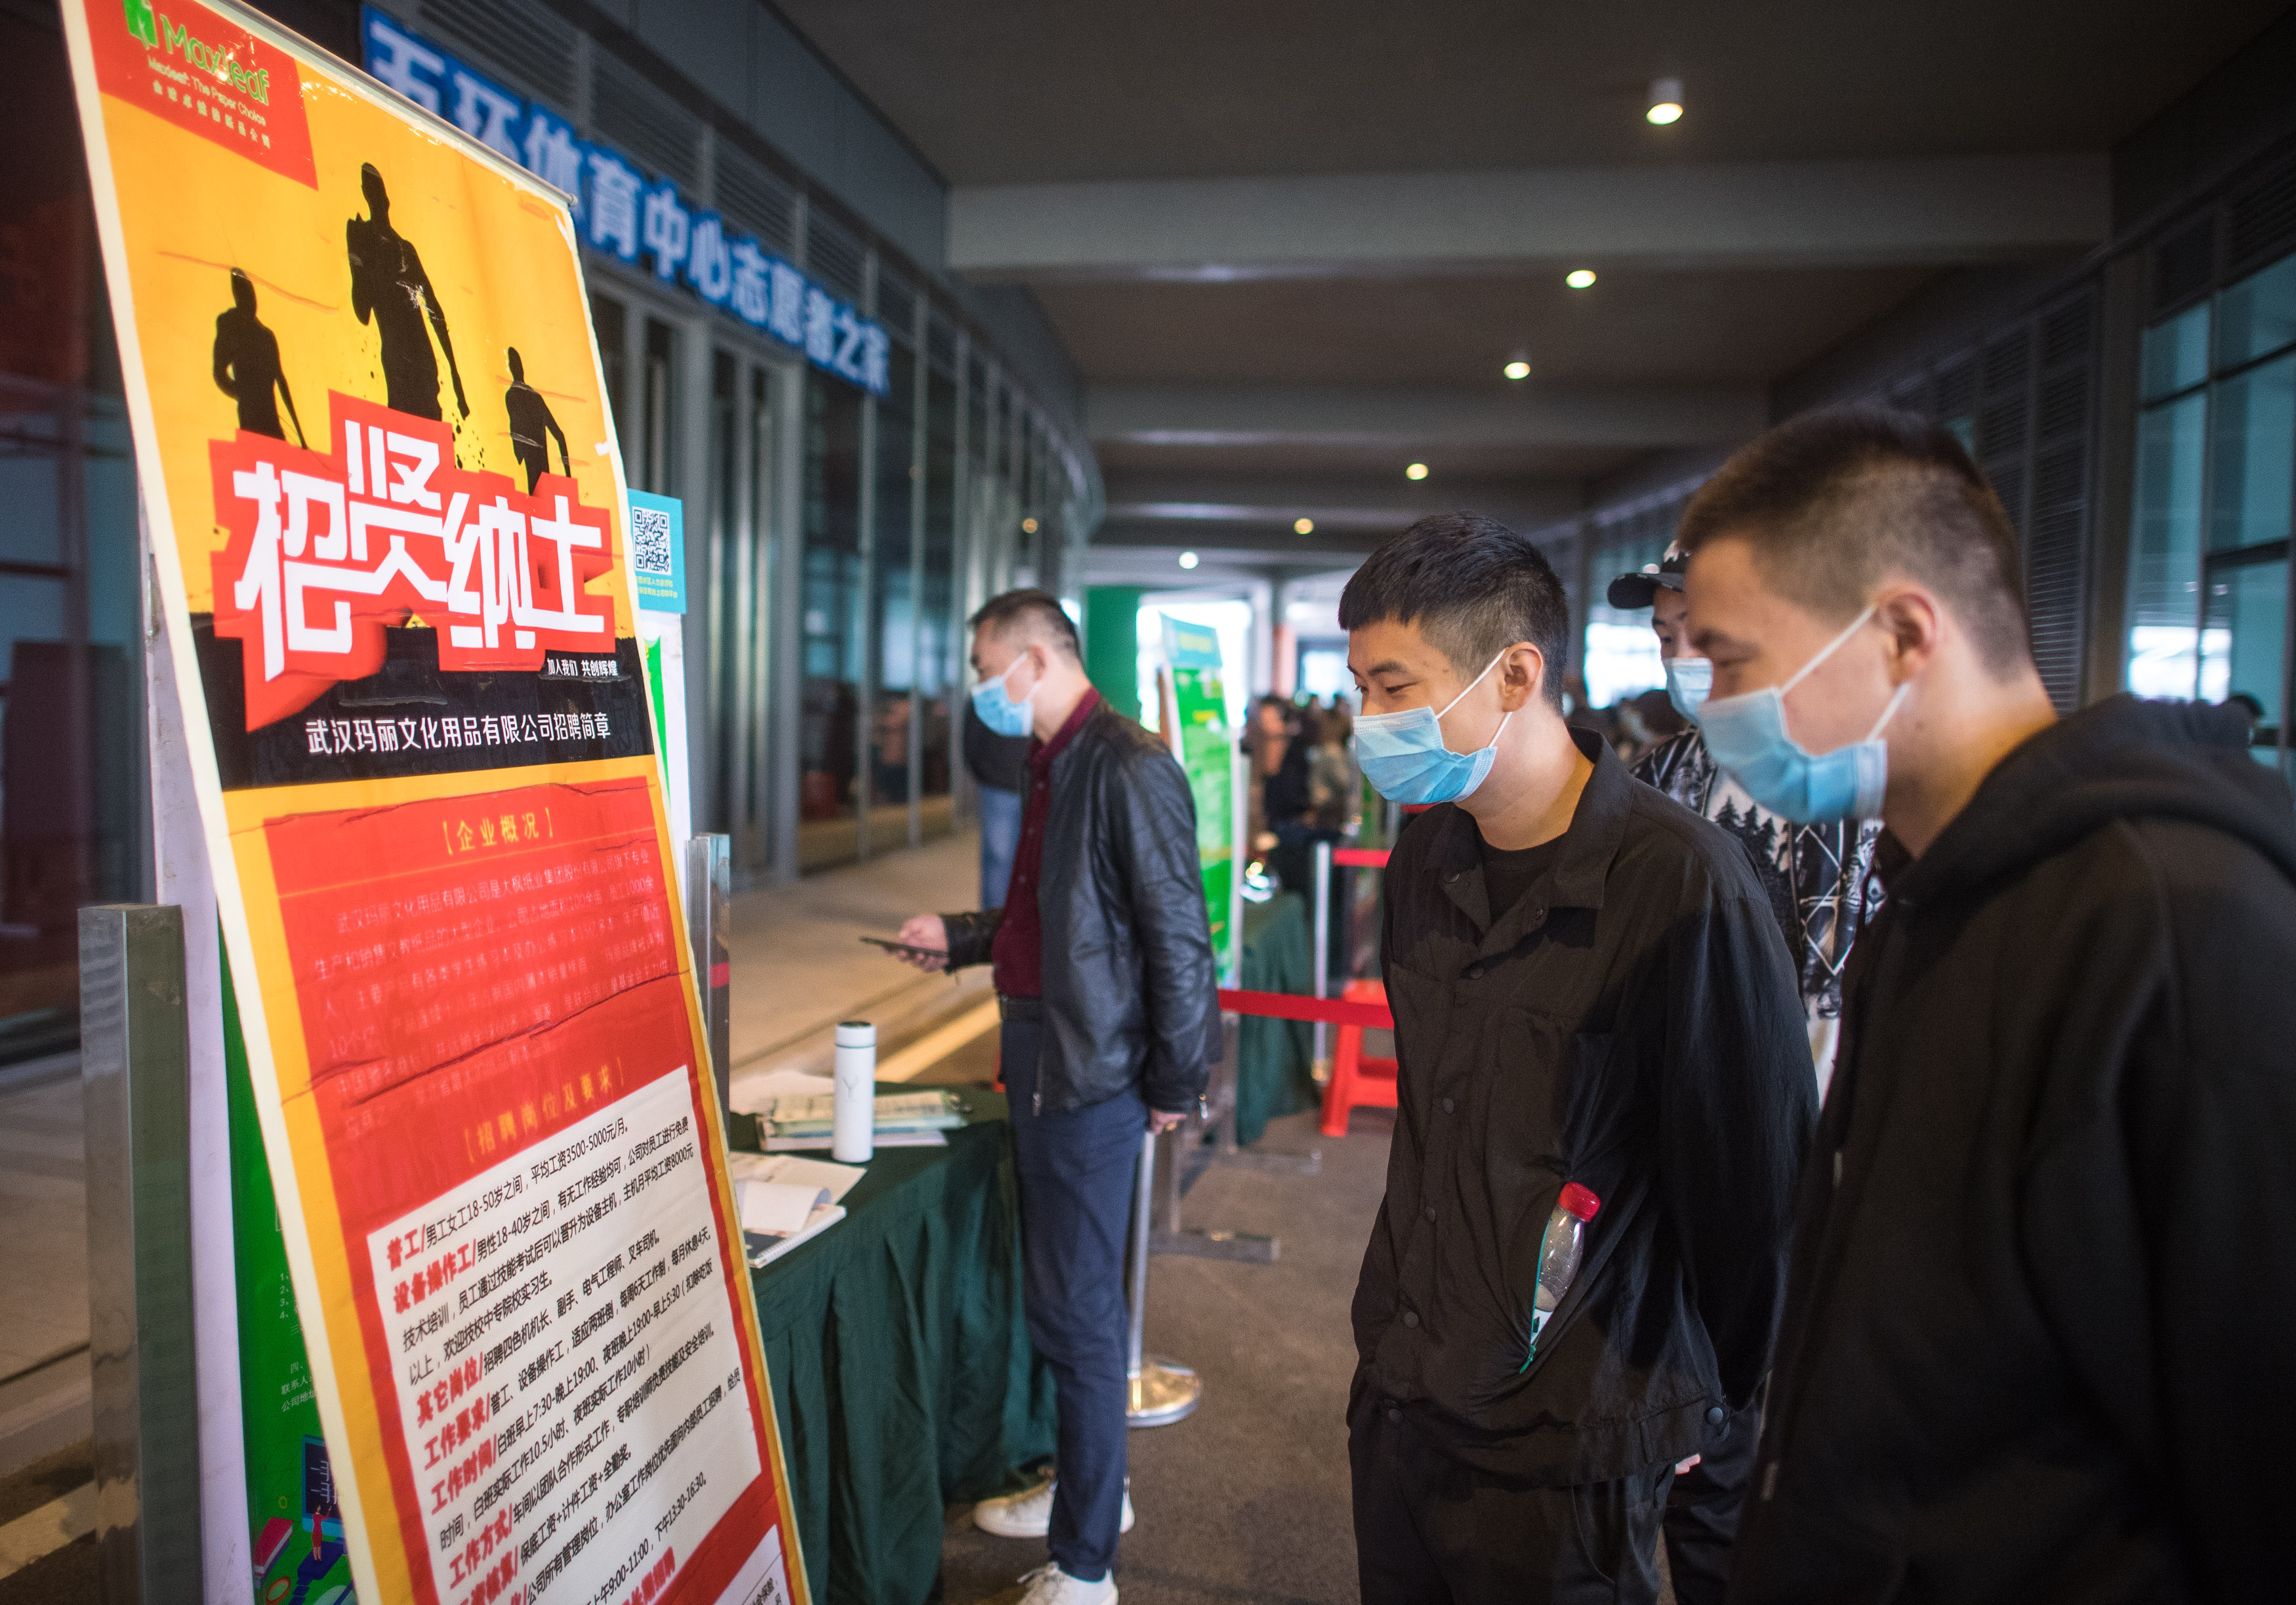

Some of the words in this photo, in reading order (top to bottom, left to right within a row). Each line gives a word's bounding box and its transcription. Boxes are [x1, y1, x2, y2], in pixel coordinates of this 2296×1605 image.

[159, 13, 270, 106] Maxleaf
[191, 75, 211, 96] The
[211, 86, 237, 111] Paper
[237, 101, 266, 127] Choice
[233, 419, 605, 682] 招贤纳士
[306, 713, 611, 755] 武汉玛丽文化用品有限公司招聘简章
[547, 657, 579, 677] 加入我们
[581, 659, 618, 677] 共创辉煌
[387, 1117, 628, 1272] 普工/男工女工18-50岁之间，平均工资3500-5000元/月。
[403, 1142, 693, 1353] 技术培训，员工通过技能考试后可以晋升为设备主机，主机月平均工资8000元
[409, 1270, 552, 1386] 以上，欢迎技校中专院校实习生。
[417, 1229, 659, 1429] 其它岗位/招聘四色机机长、副手、电气工程师、叉车司机。
[440, 1344, 651, 1552] 时间，白班实际工作10.5小时、夜班实际工作10小时）
[458, 1442, 631, 1605] 资核算/保底工资+计件工资+全勤奖。
[586, 1471, 707, 1605] 上午9:00-11:00，下午13:30-16:30。
